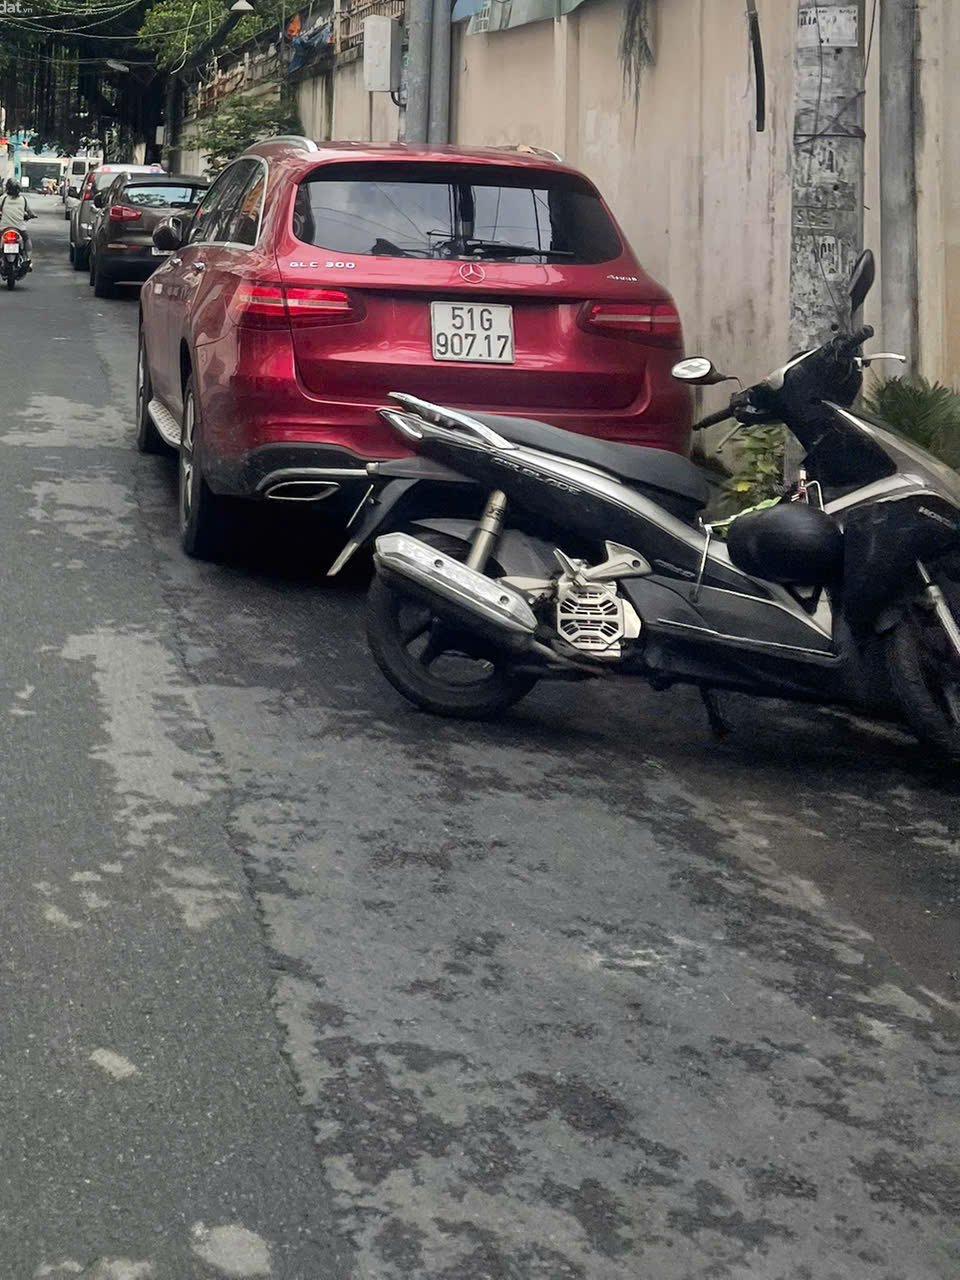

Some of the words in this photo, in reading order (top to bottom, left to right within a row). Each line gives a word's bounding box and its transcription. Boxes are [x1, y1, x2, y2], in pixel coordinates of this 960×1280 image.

[289, 261, 319, 269] GLC
[325, 261, 356, 270] 300
[451, 306, 493, 331] 51G
[436, 332, 509, 359] 907.17
